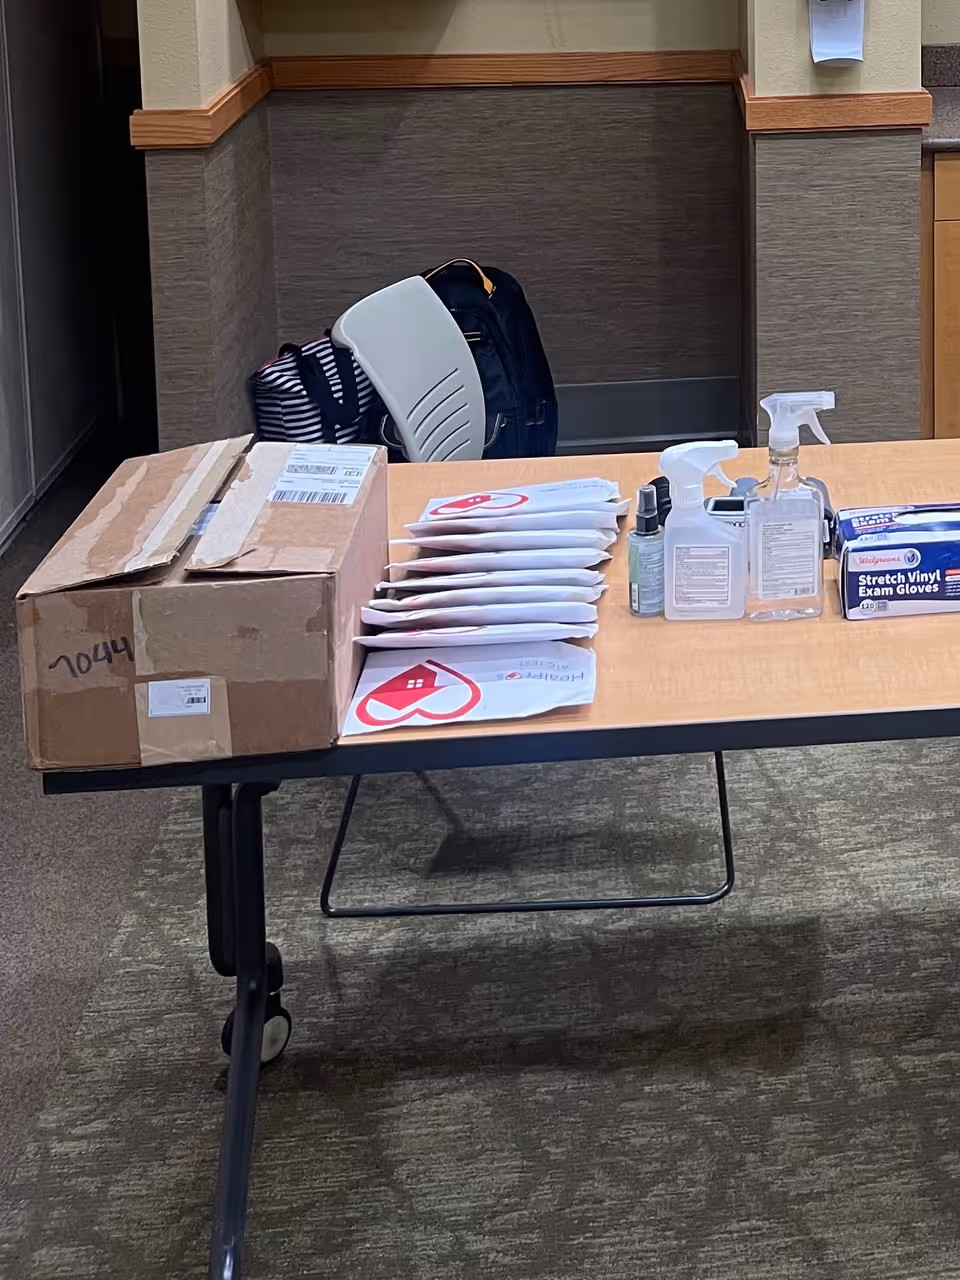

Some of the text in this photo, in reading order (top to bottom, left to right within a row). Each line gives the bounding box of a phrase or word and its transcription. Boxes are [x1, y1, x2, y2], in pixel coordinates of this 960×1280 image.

[858, 572, 906, 586] Stretch
[907, 569, 941, 584] Vinyl
[858, 586, 894, 597] Exam
[896, 583, 939, 595] Gloves
[48, 636, 135, 678] 7044
